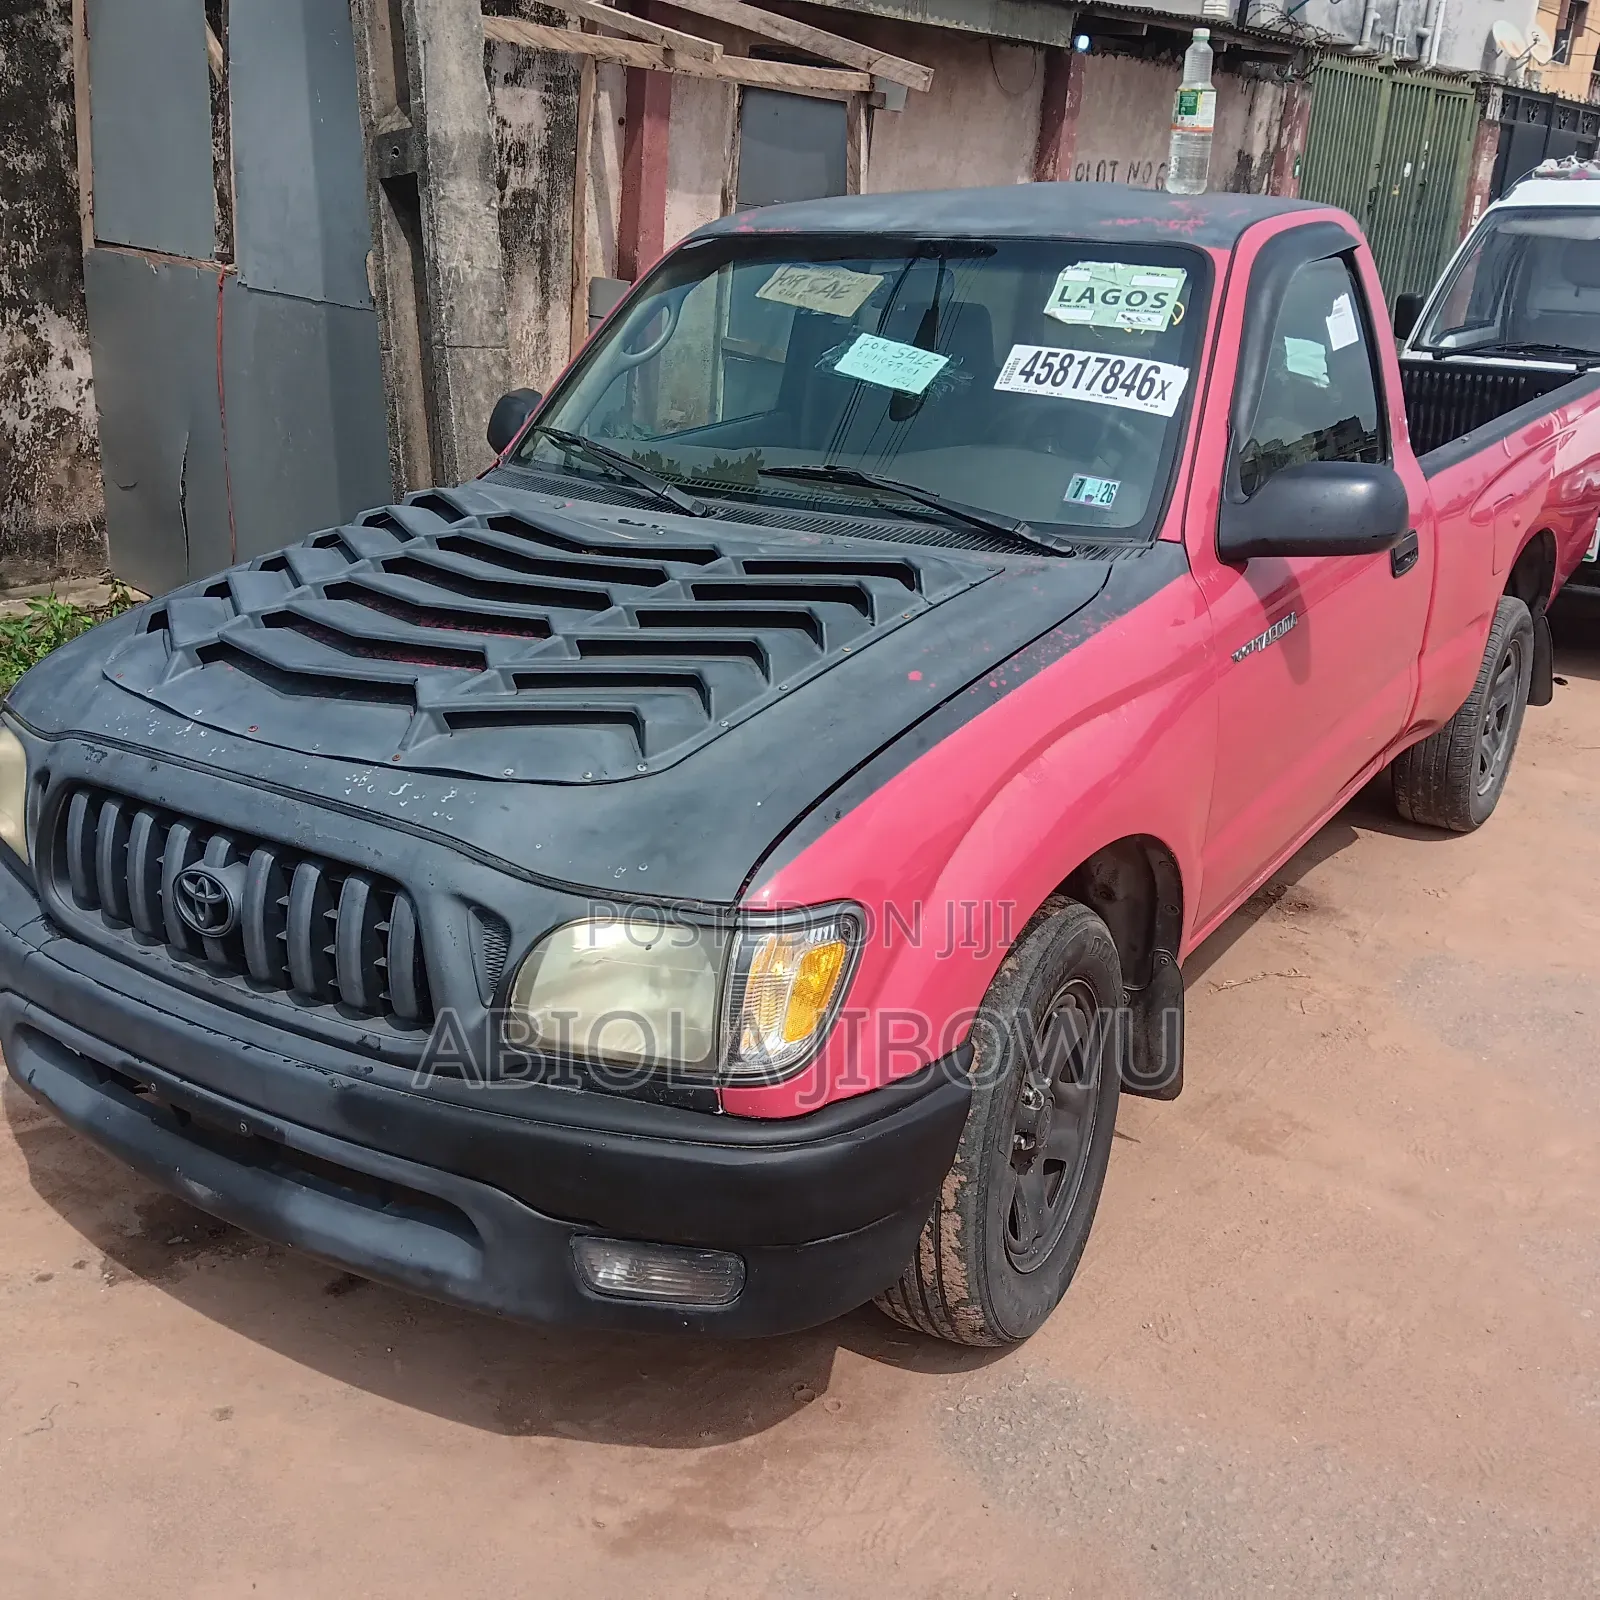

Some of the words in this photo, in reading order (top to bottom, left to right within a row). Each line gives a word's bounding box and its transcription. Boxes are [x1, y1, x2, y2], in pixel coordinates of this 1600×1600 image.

[1058, 286, 1169, 309] LAGOS
[859, 337, 890, 350] FOR
[892, 347, 939, 368] SALE
[1072, 478, 1087, 499] 7
[1099, 483, 1117, 503] 26
